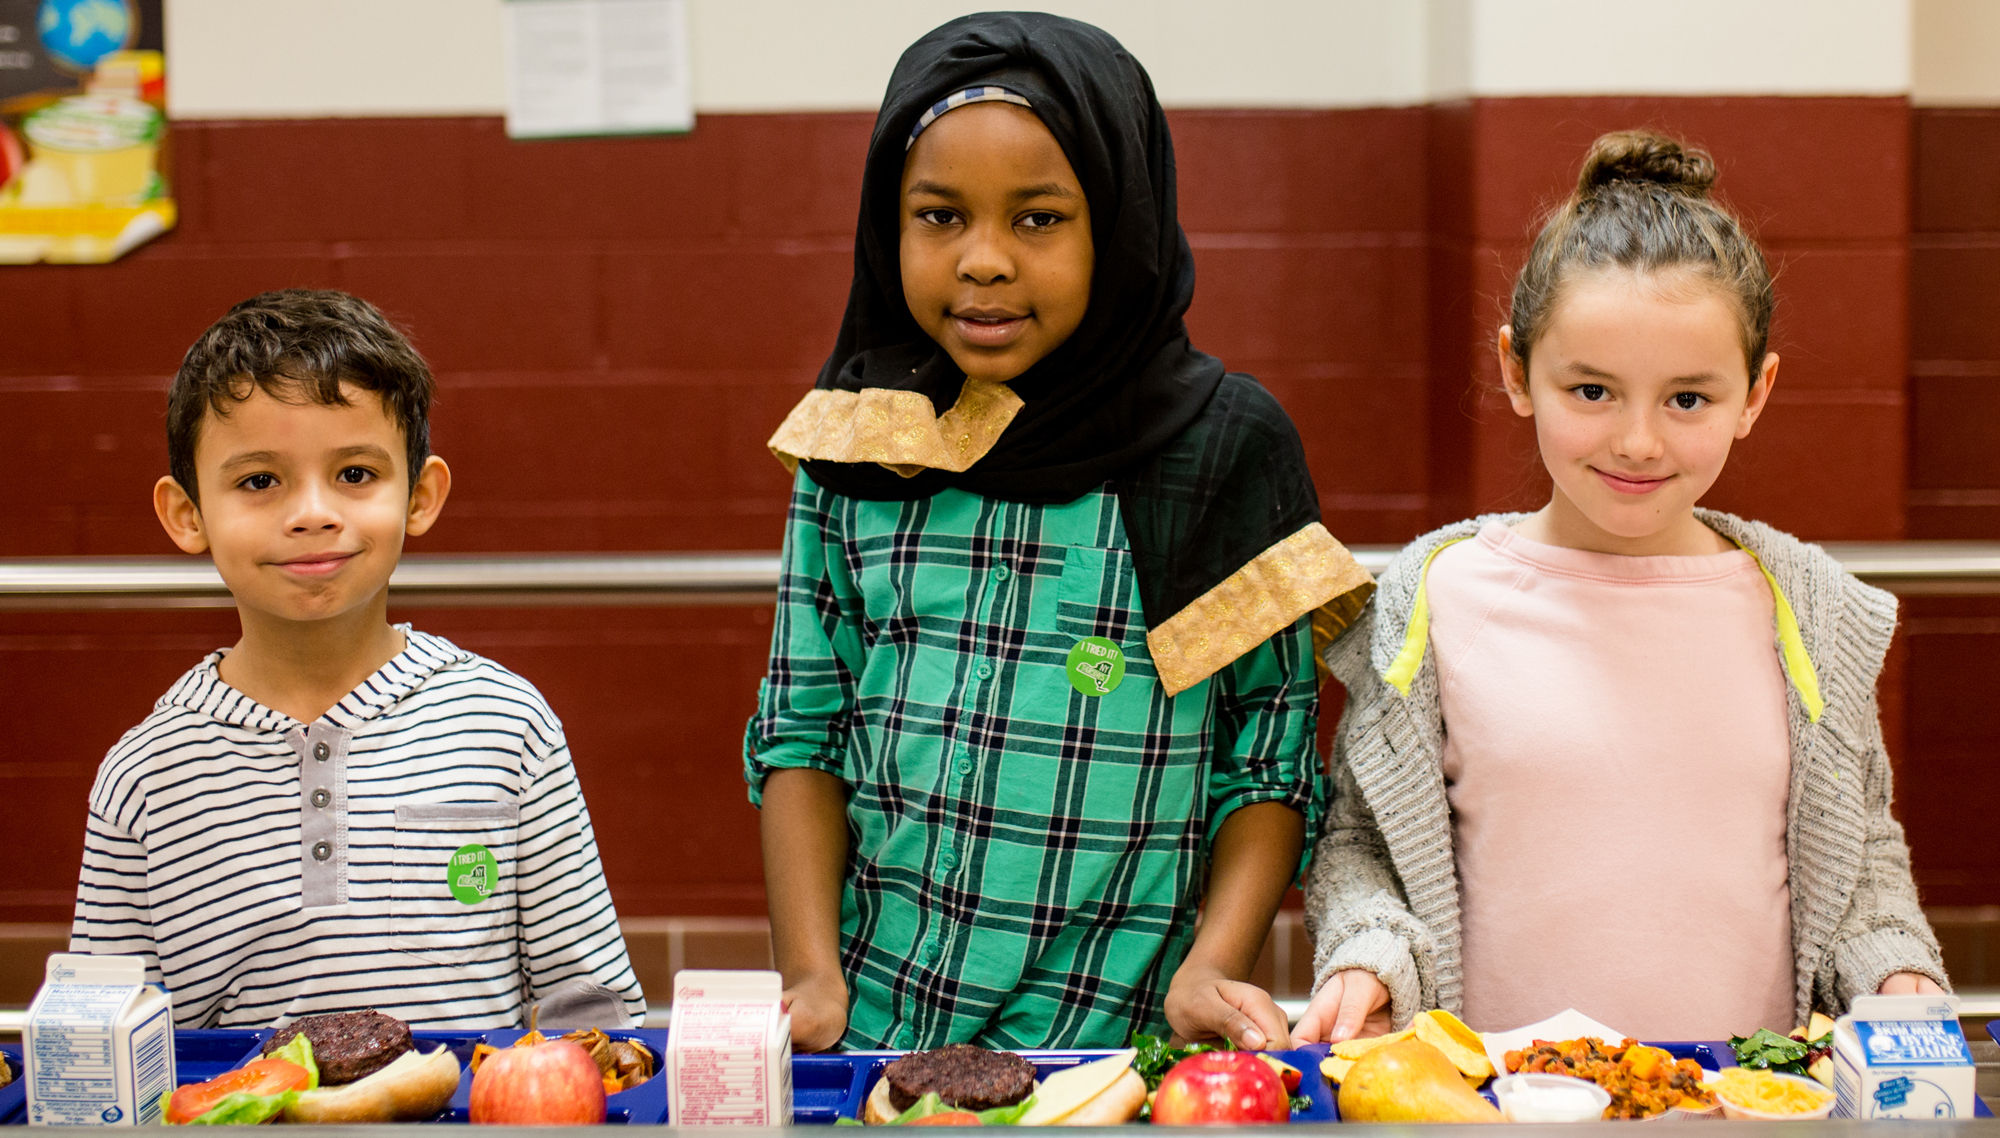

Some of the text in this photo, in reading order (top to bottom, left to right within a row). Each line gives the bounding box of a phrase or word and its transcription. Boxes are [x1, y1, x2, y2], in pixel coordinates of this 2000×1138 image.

[1081, 641, 1118, 661] I TRIED IT!
[1099, 664, 1110, 673] NY
[453, 851, 486, 866] I TRIED IT!
[475, 868, 484, 877] NY
[1873, 1027, 1946, 1036] SKIM MILK
[1899, 1034, 1960, 1046] BYRNE
[1909, 1044, 1963, 1058] DAIRY
[1882, 1081, 1896, 1089] Does
